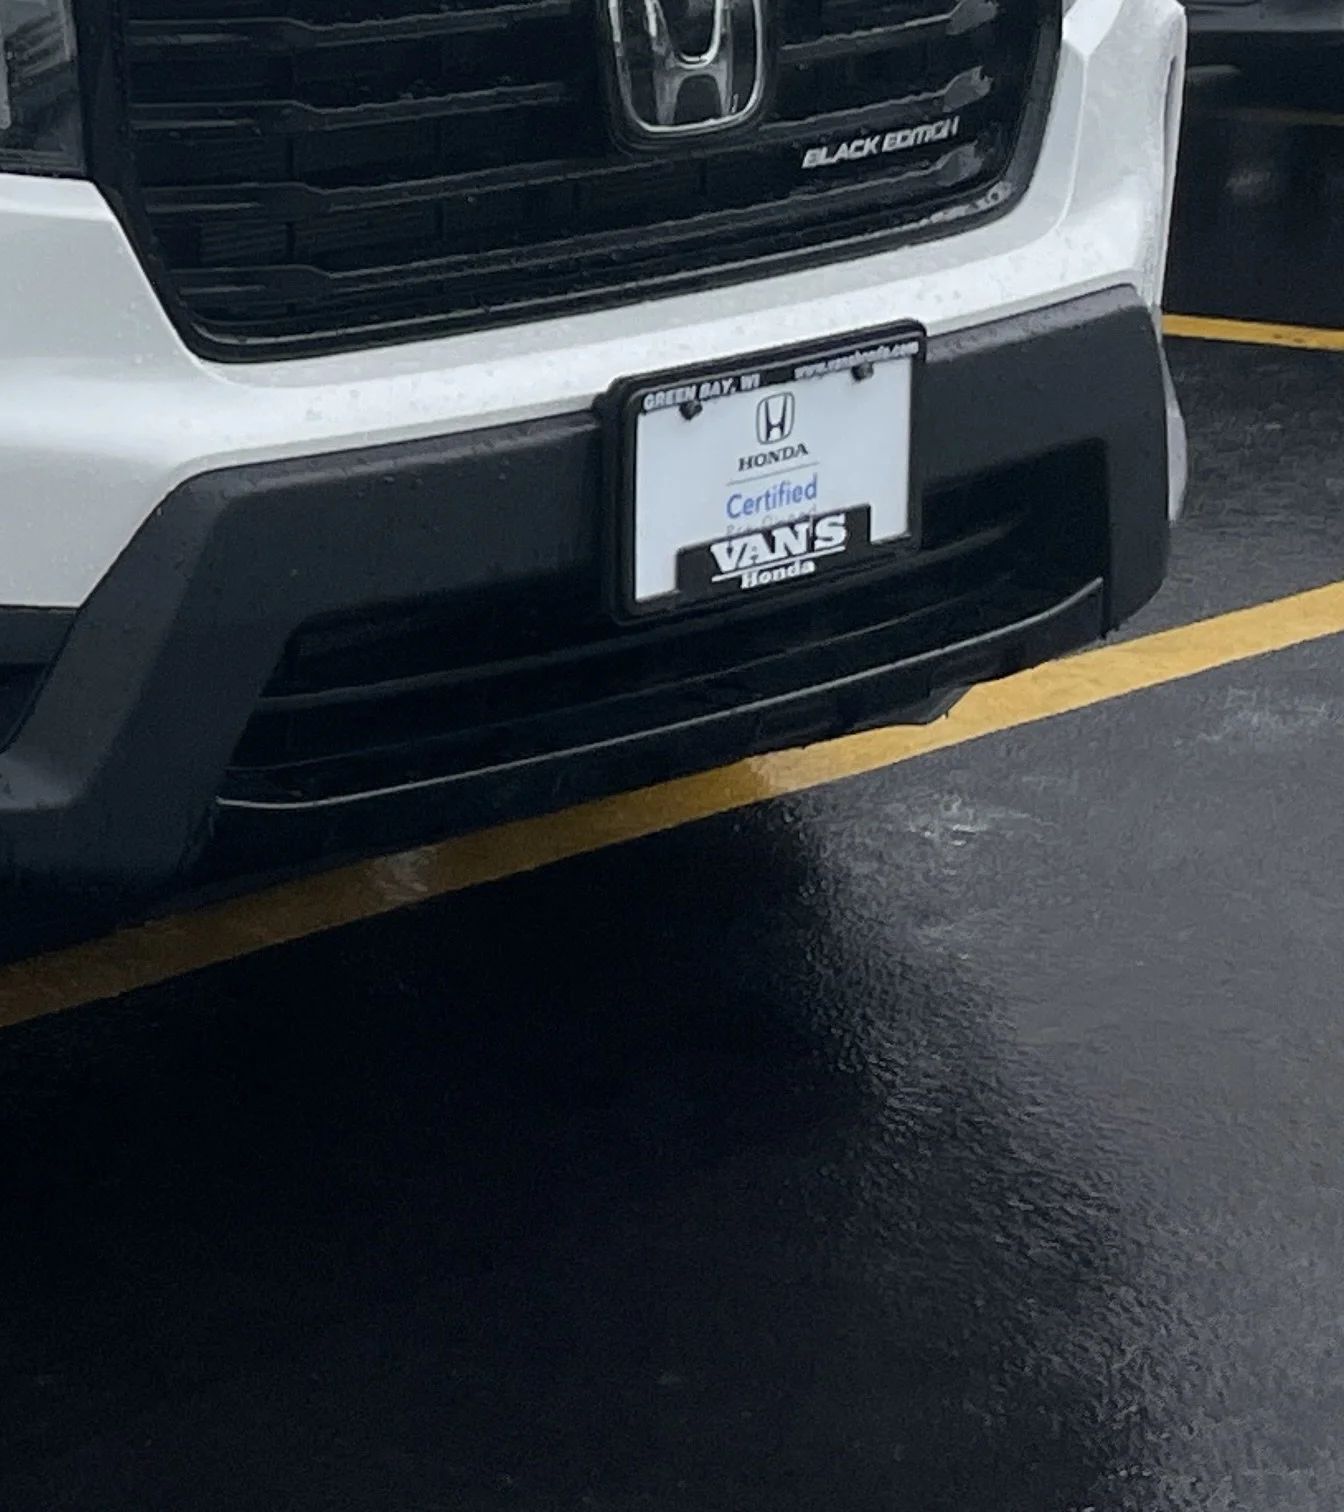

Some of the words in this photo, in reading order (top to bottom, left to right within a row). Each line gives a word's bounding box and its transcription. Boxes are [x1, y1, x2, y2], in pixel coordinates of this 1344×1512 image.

[801, 134, 881, 169] BLACK
[643, 384, 697, 410] GREEN
[738, 443, 809, 471] HONDA
[726, 472, 817, 519] Certified
[740, 560, 816, 590] Honda
